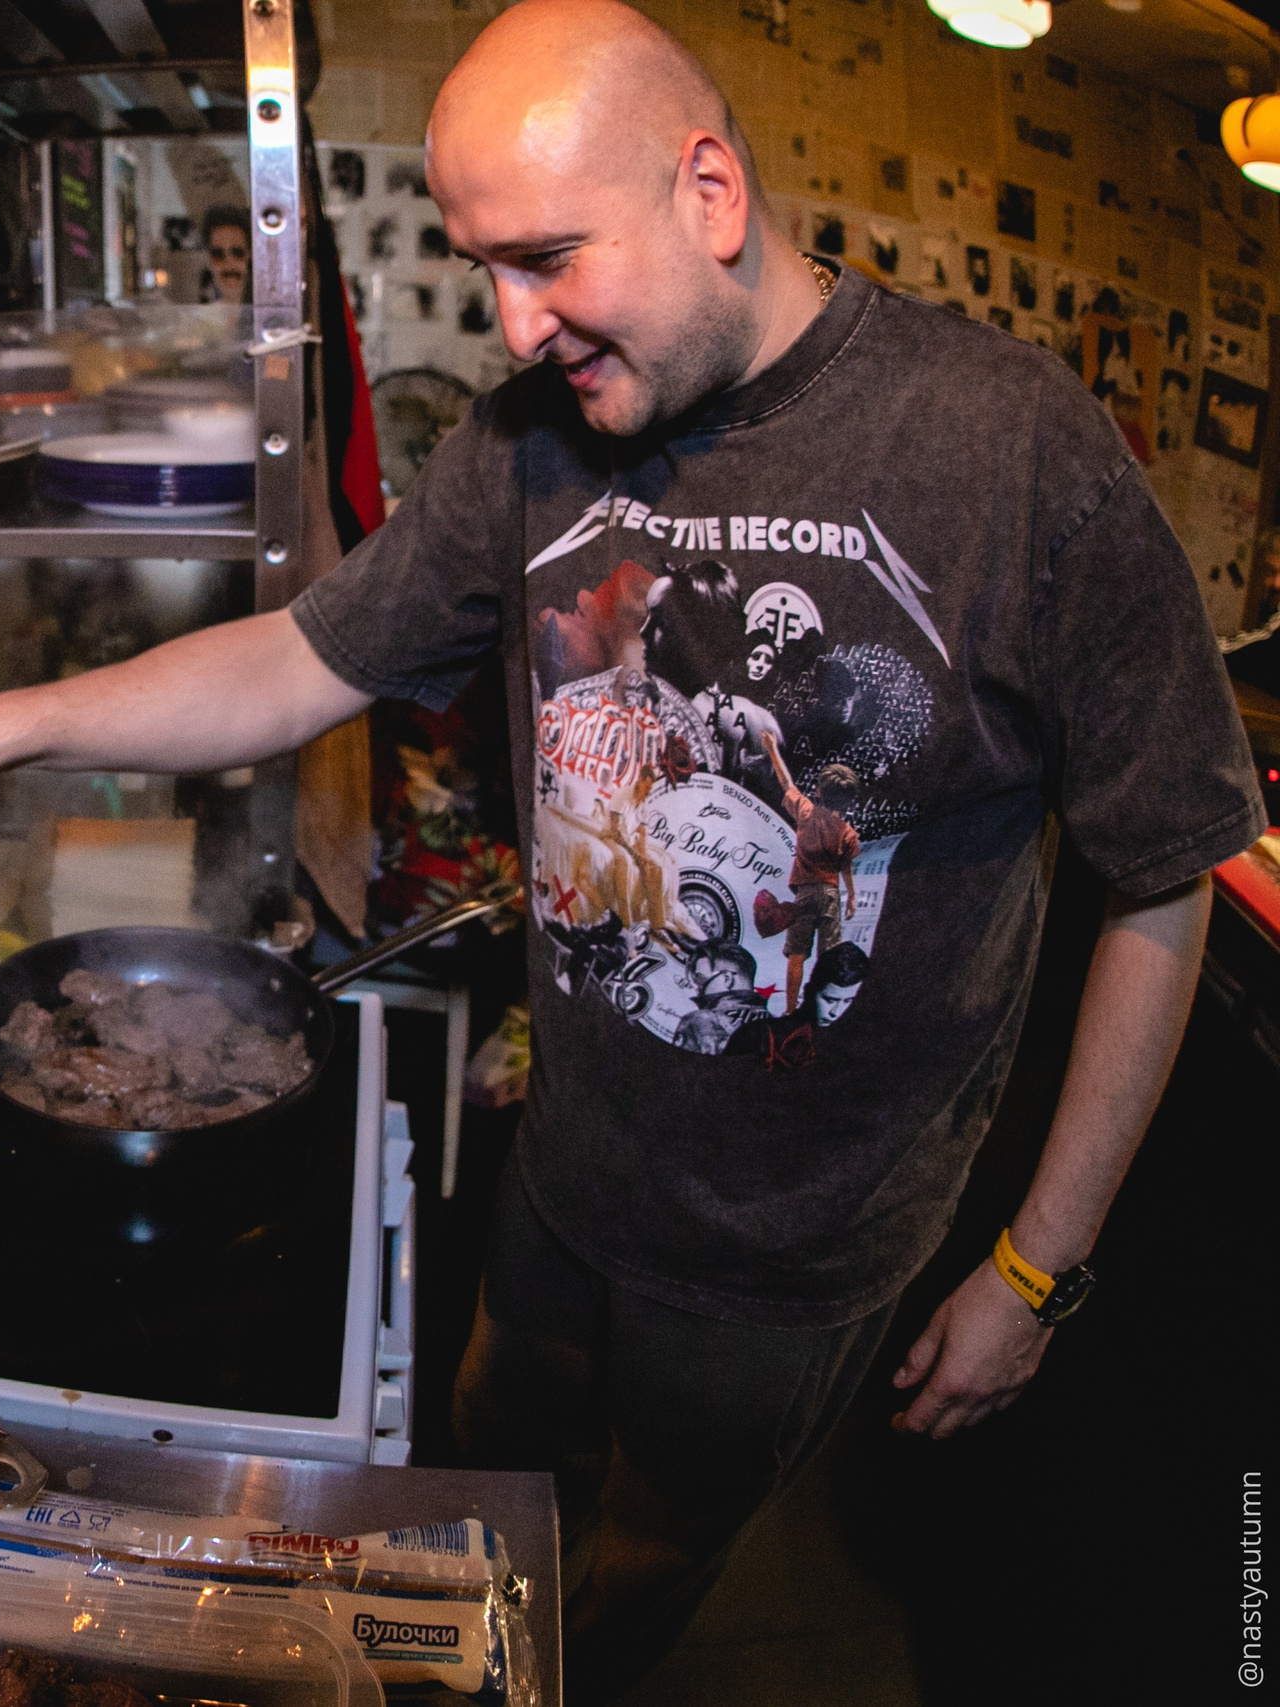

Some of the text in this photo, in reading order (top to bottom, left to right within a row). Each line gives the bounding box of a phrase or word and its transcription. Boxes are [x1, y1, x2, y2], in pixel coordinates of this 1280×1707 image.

[722, 784, 753, 808] BENZO
[754, 806, 772, 824] Anti
[648, 810, 676, 850] Big
[679, 822, 732, 872] Baby
[731, 841, 785, 885] Tape
[1007, 1264, 1035, 1291] YEARS
[356, 1616, 457, 1644] Булочки
